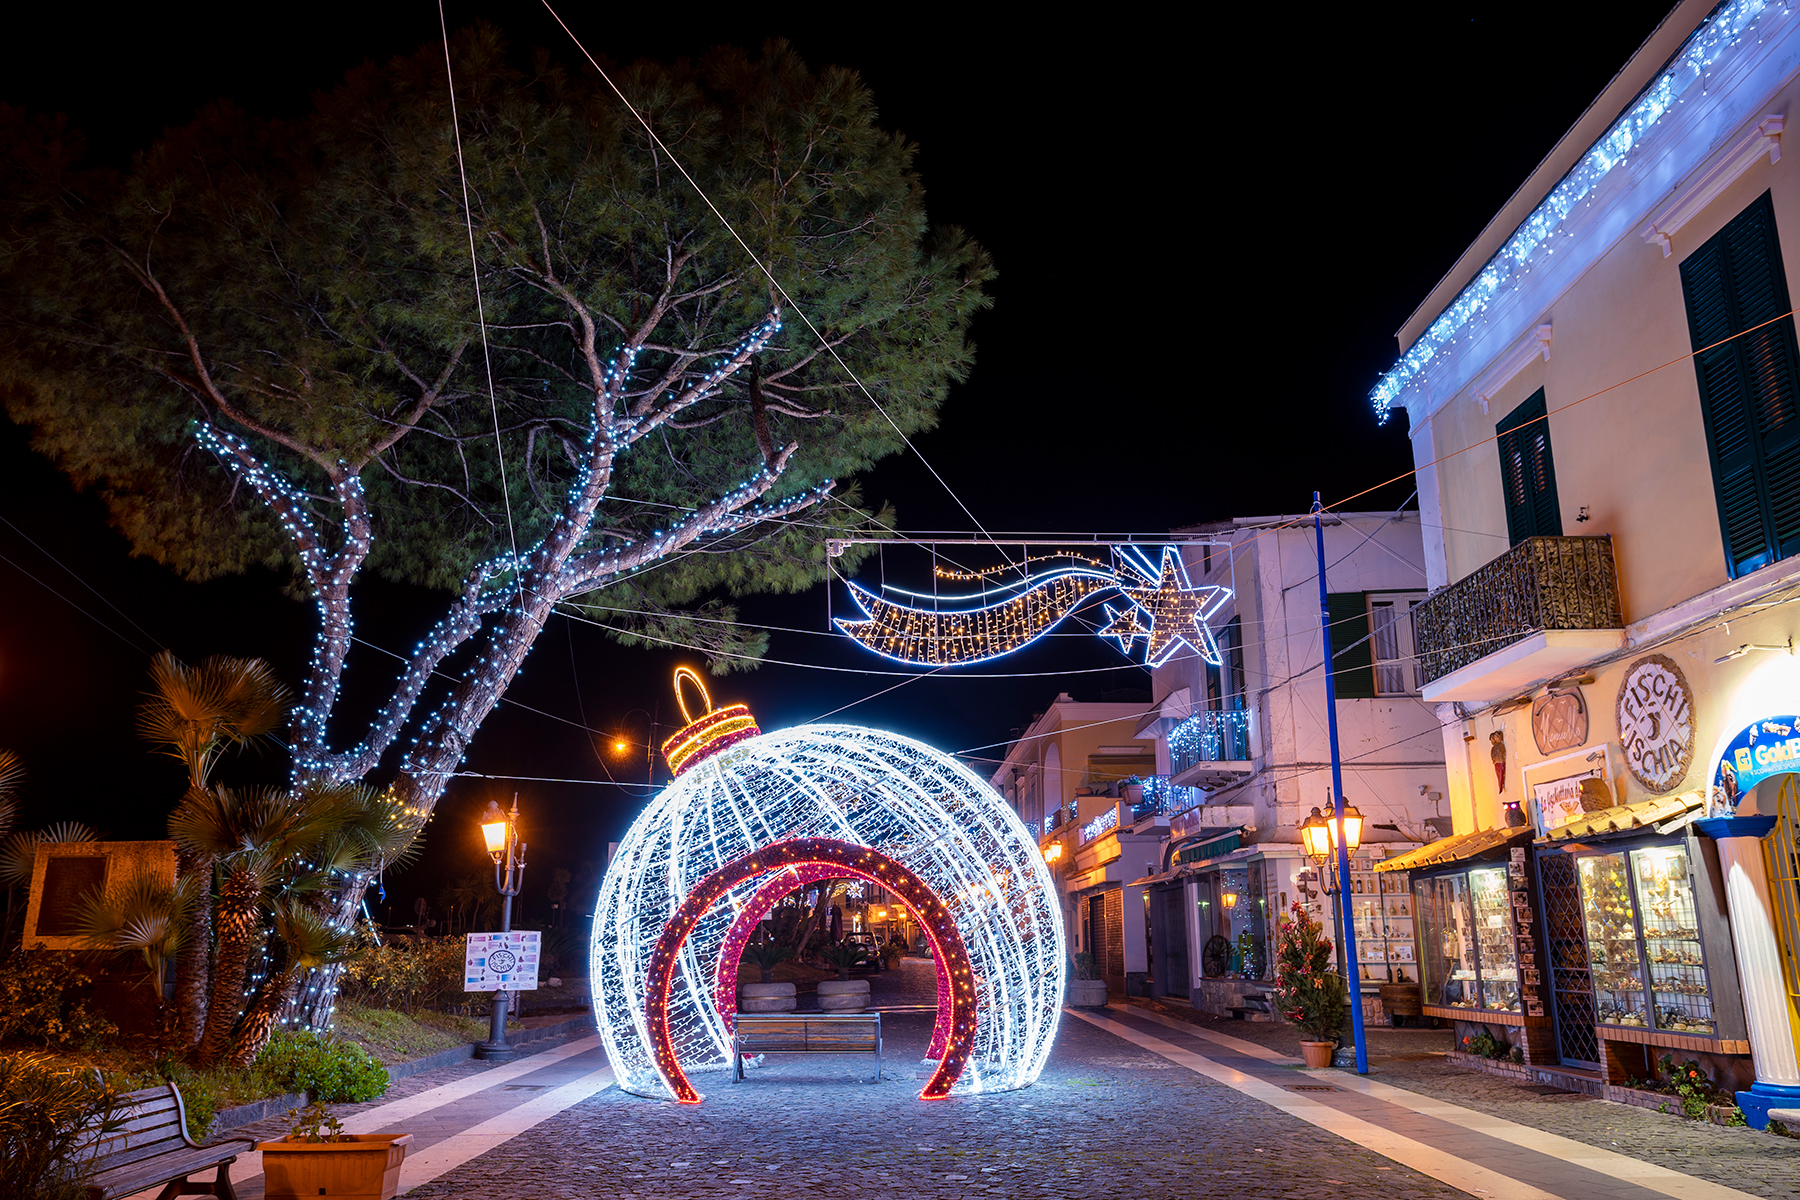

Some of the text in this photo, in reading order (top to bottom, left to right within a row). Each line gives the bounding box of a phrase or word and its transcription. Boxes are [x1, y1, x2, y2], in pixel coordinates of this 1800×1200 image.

[1624, 674, 1687, 721] FISCHI
[1626, 730, 1687, 774] ISCHIA
[491, 962, 512, 972] ISCHIA
[492, 953, 514, 962] FISCHI
